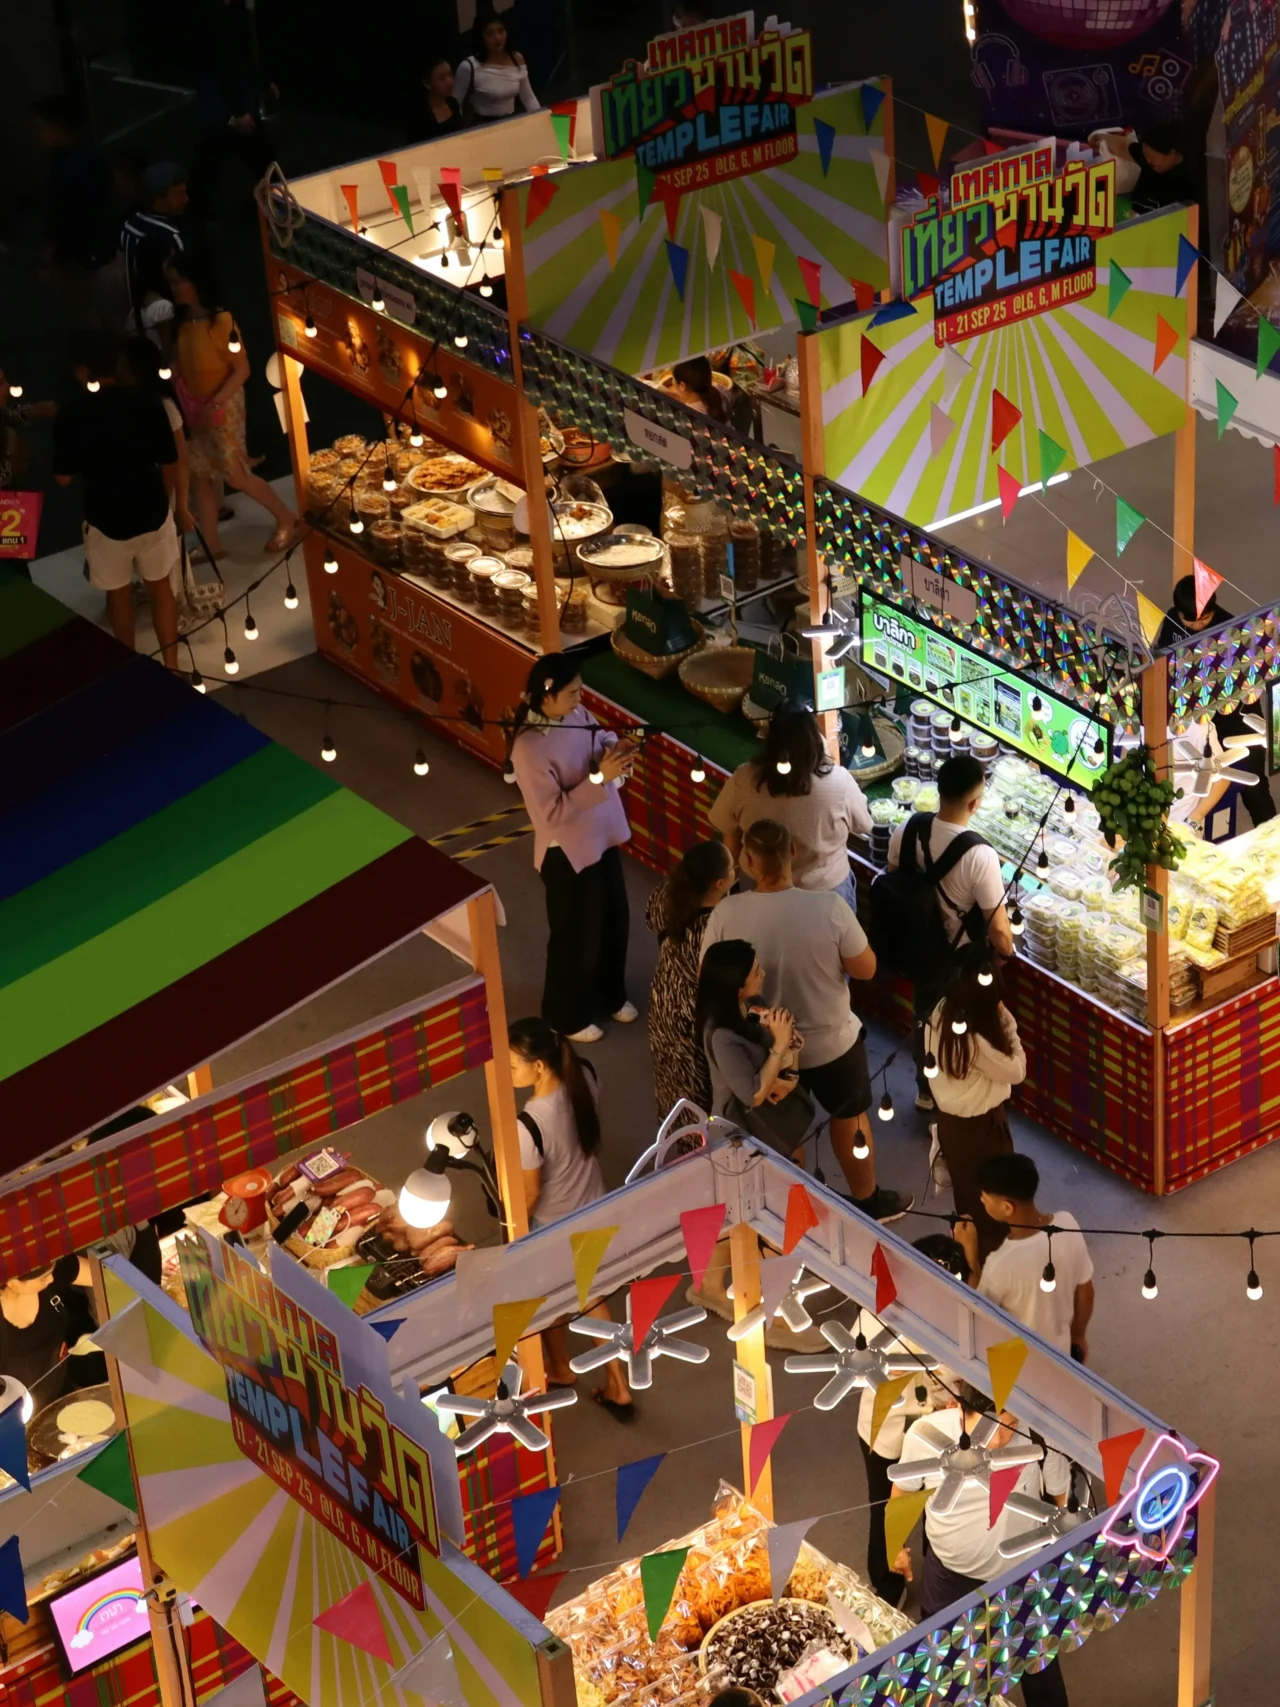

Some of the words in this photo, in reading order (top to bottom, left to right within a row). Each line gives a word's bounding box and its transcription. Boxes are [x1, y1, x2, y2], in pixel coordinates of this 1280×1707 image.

[649, 17, 748, 72] เทศกาล
[674, 168, 693, 188] SEP
[696, 164, 709, 182] 25
[754, 149, 762, 163] M
[765, 137, 795, 161] FLOOR
[953, 147, 1053, 206] เทศกาล
[938, 321, 947, 340] 11
[957, 316, 968, 335] 21
[971, 310, 990, 330] SEP
[993, 302, 1006, 321] 25
[1013, 293, 1036, 314] @LG,
[1039, 289, 1049, 306] G,
[1052, 285, 1060, 300] M
[1063, 271, 1093, 297] FLOOR
[873, 612, 916, 650] บาลิกา
[234, 1416, 246, 1443] 11
[256, 1439, 270, 1466] 21
[271, 1452, 293, 1488] SEP
[296, 1474, 314, 1505] 25
[319, 1493, 350, 1543] @LG,
[352, 1521, 366, 1553] G,
[367, 1533, 379, 1562] M
[380, 1546, 421, 1601] FLOOR
